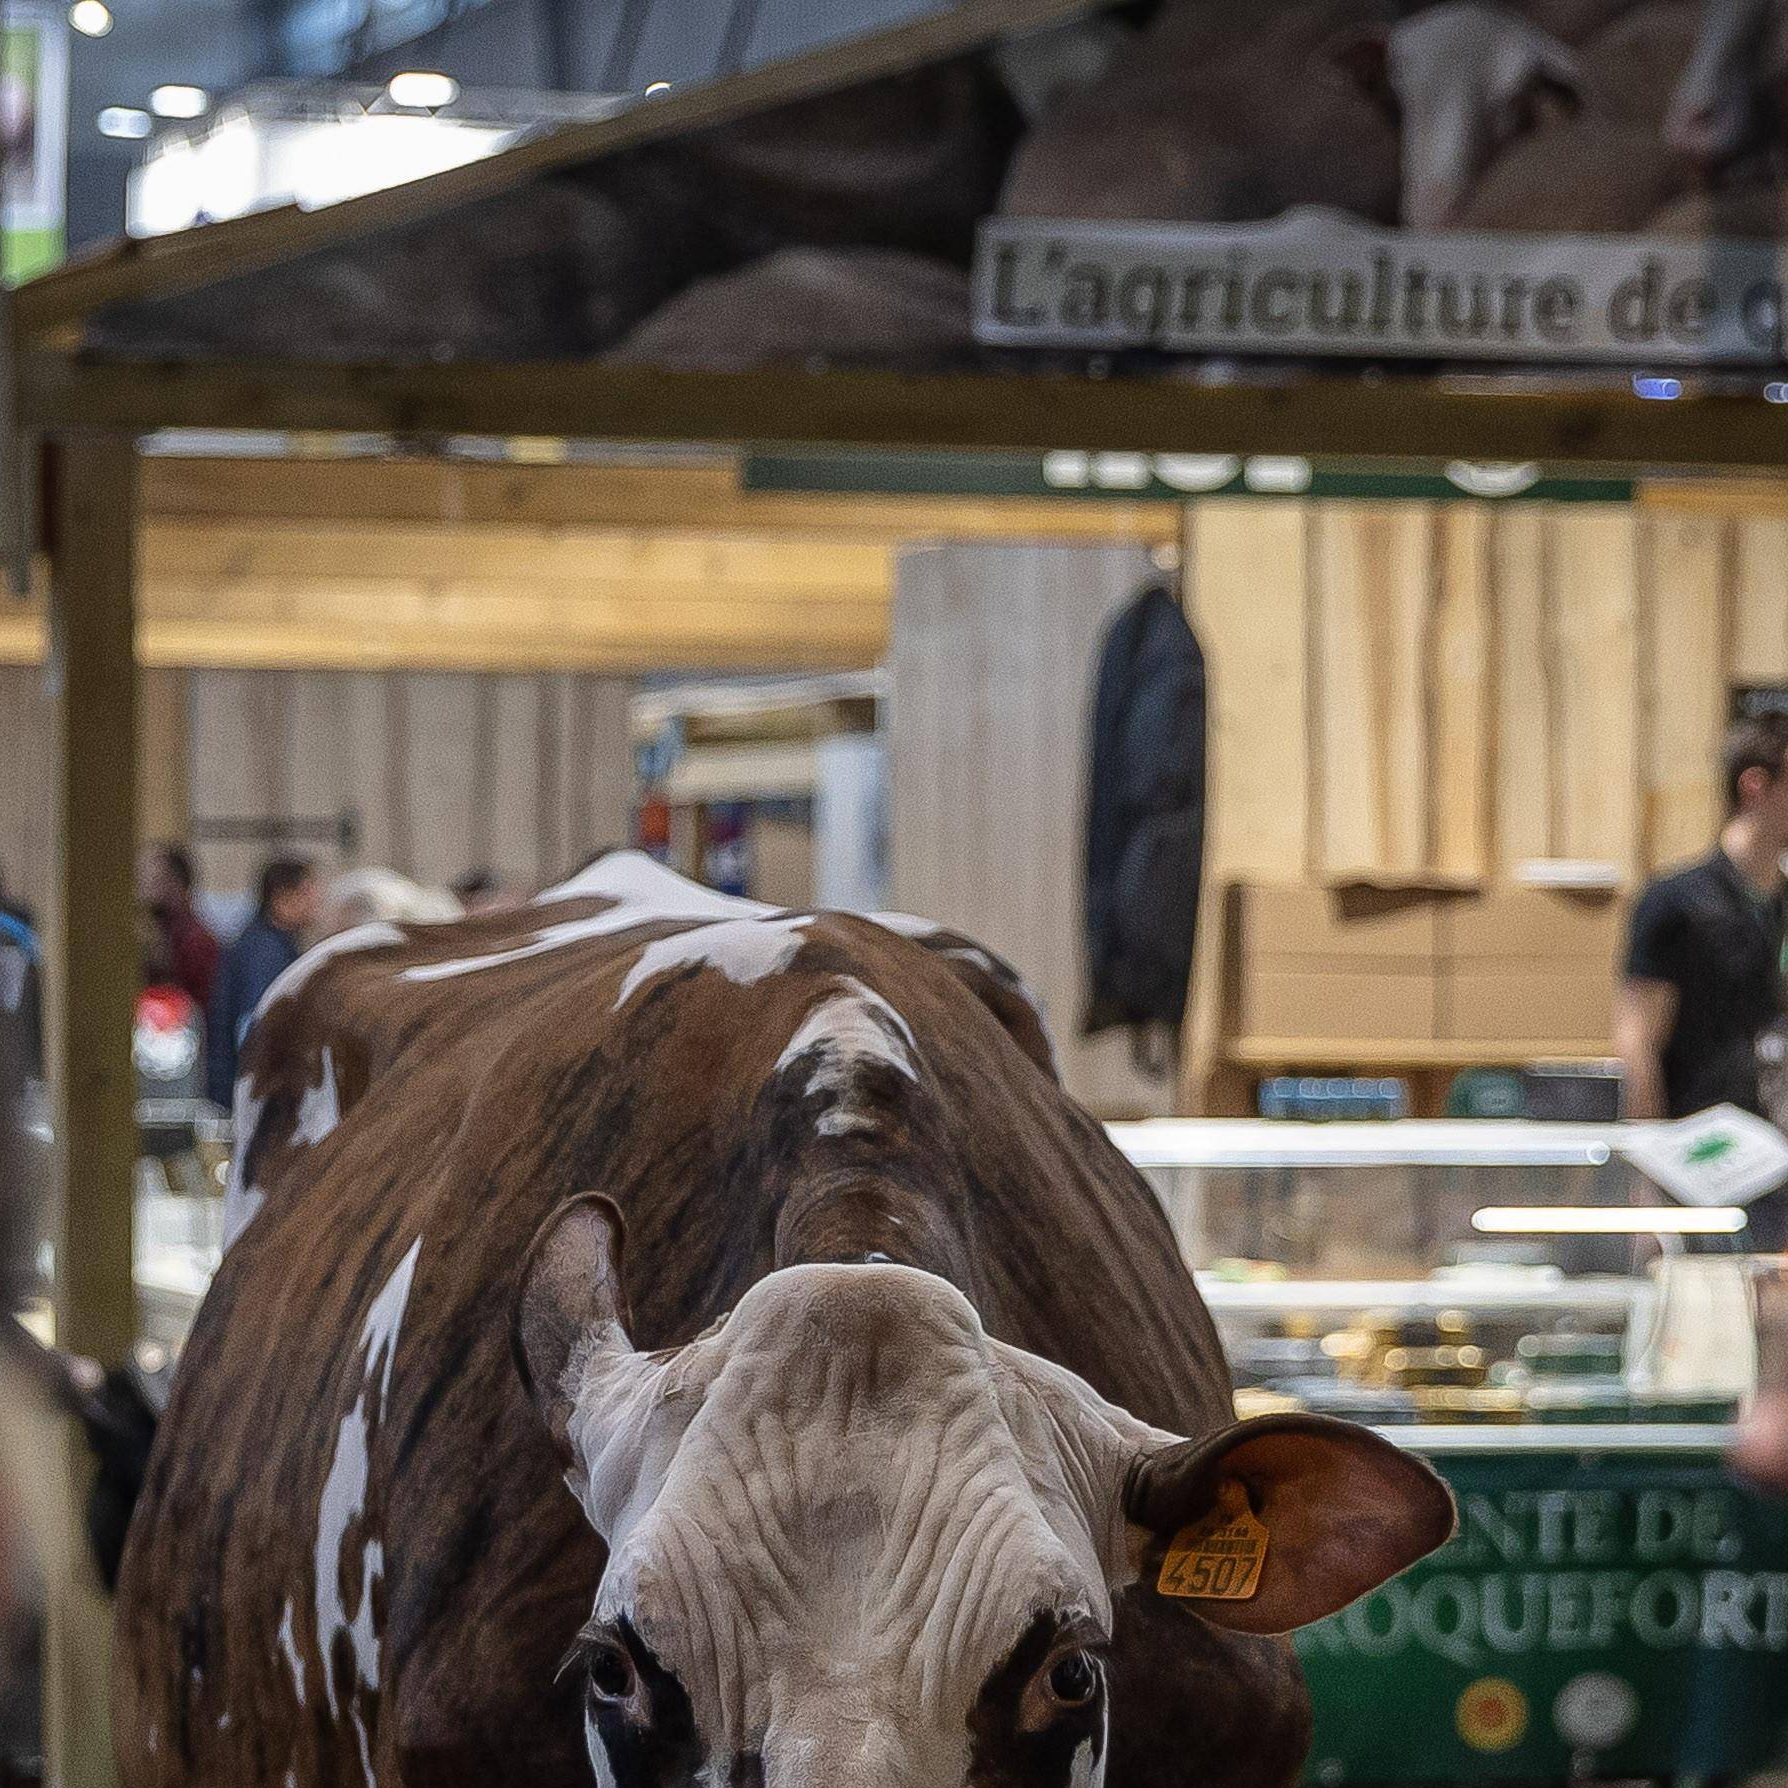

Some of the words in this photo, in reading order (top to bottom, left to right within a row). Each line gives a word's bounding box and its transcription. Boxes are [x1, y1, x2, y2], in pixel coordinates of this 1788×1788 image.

[993, 242, 1575, 344] L'agriculture
[1603, 250, 1711, 346] de
[1415, 1488, 1611, 1564] NTE
[1165, 1552, 1258, 1592] 4507
